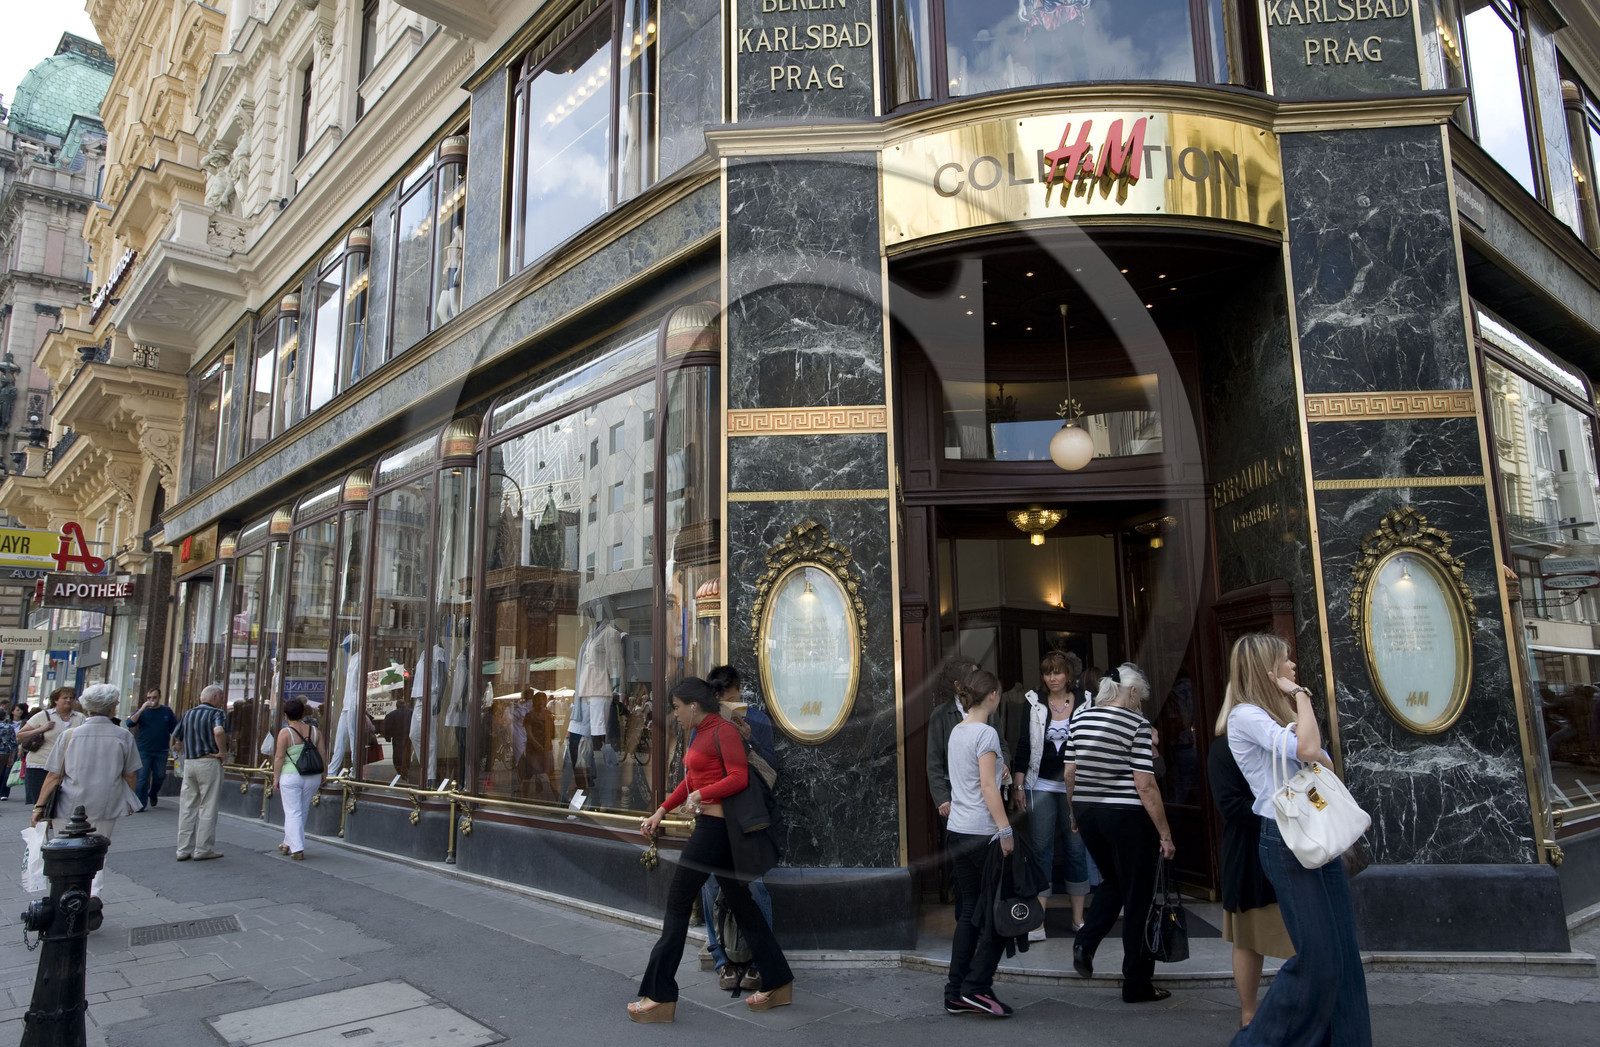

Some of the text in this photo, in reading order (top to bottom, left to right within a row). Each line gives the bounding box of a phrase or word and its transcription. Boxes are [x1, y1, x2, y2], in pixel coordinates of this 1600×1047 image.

[1265, 0, 1410, 26] KARLSBAD
[738, 22, 872, 53] KARLSBAD
[1304, 35, 1383, 66] PRAG
[770, 64, 845, 91] PRAG
[1044, 117, 1147, 187] H&M
[933, 145, 1240, 197] COLLTION
[1454, 184, 1485, 215] piegelgasse
[0, 534, 31, 554] AYR
[53, 583, 129, 598] APOTHEKE
